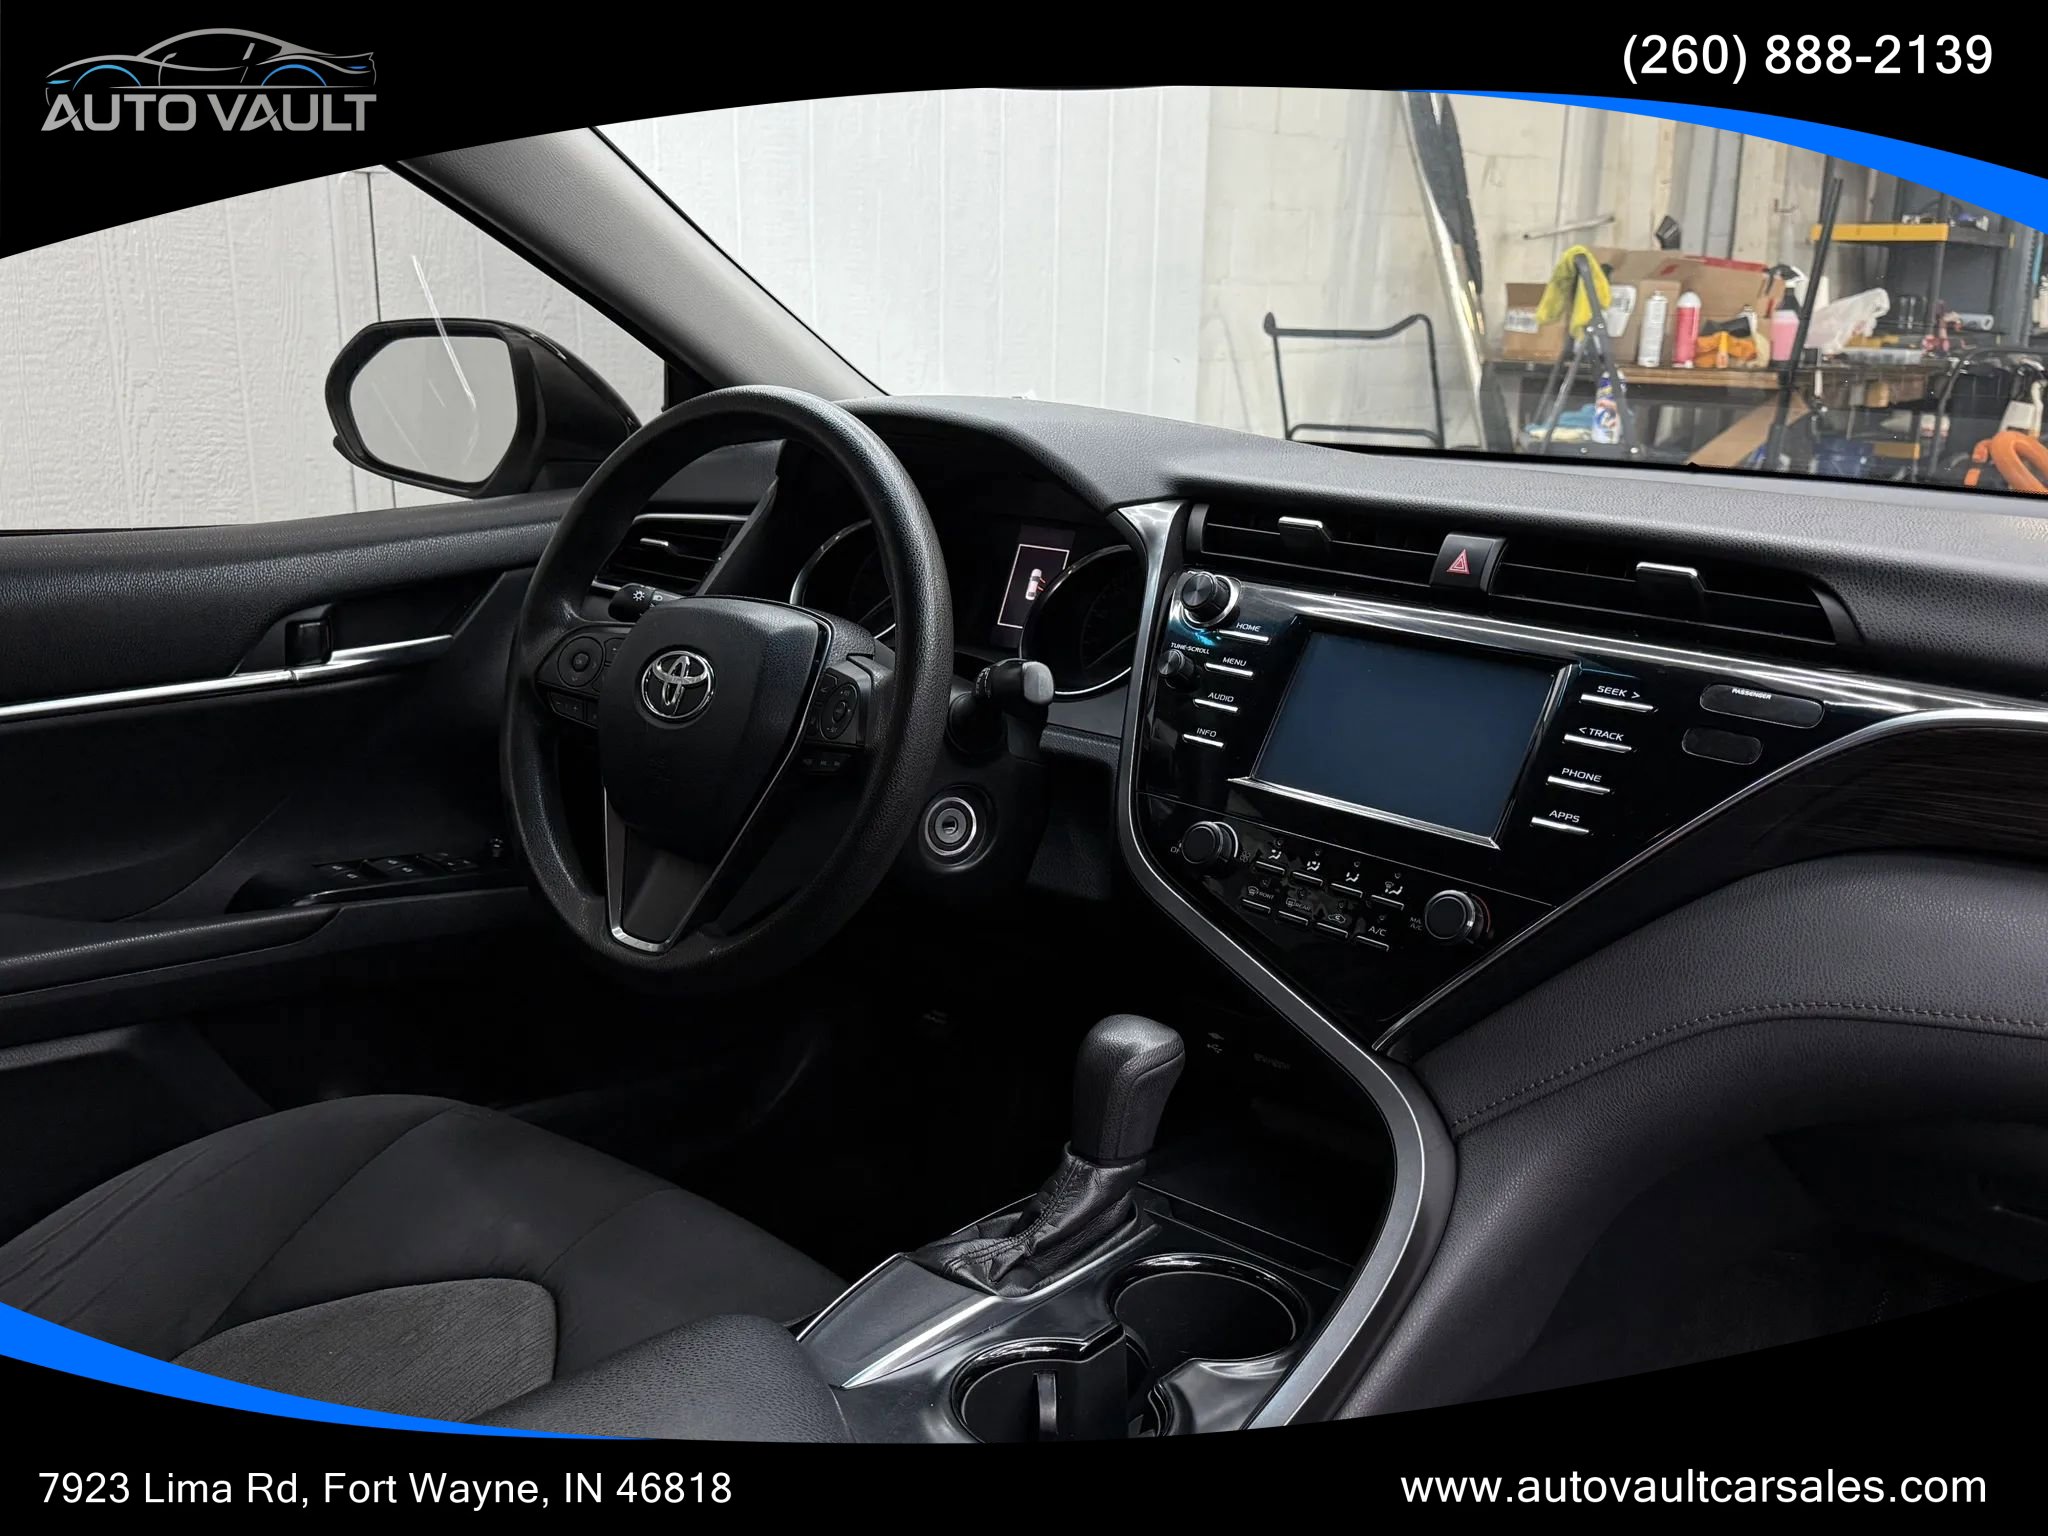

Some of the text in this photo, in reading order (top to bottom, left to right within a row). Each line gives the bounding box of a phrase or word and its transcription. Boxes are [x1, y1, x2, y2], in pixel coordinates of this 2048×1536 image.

[1236, 622, 1262, 632] HOME
[1222, 657, 1247, 667] MENU
[1596, 685, 1628, 698] SEEK
[1731, 688, 1772, 700] PASSENGER
[1208, 692, 1235, 703] AUDIO
[1196, 728, 1217, 738] INFO
[1589, 728, 1624, 741] TRACK
[1561, 767, 1602, 783] PHONE
[1549, 810, 1580, 823] APPS
[1368, 926, 1387, 937] A/C
